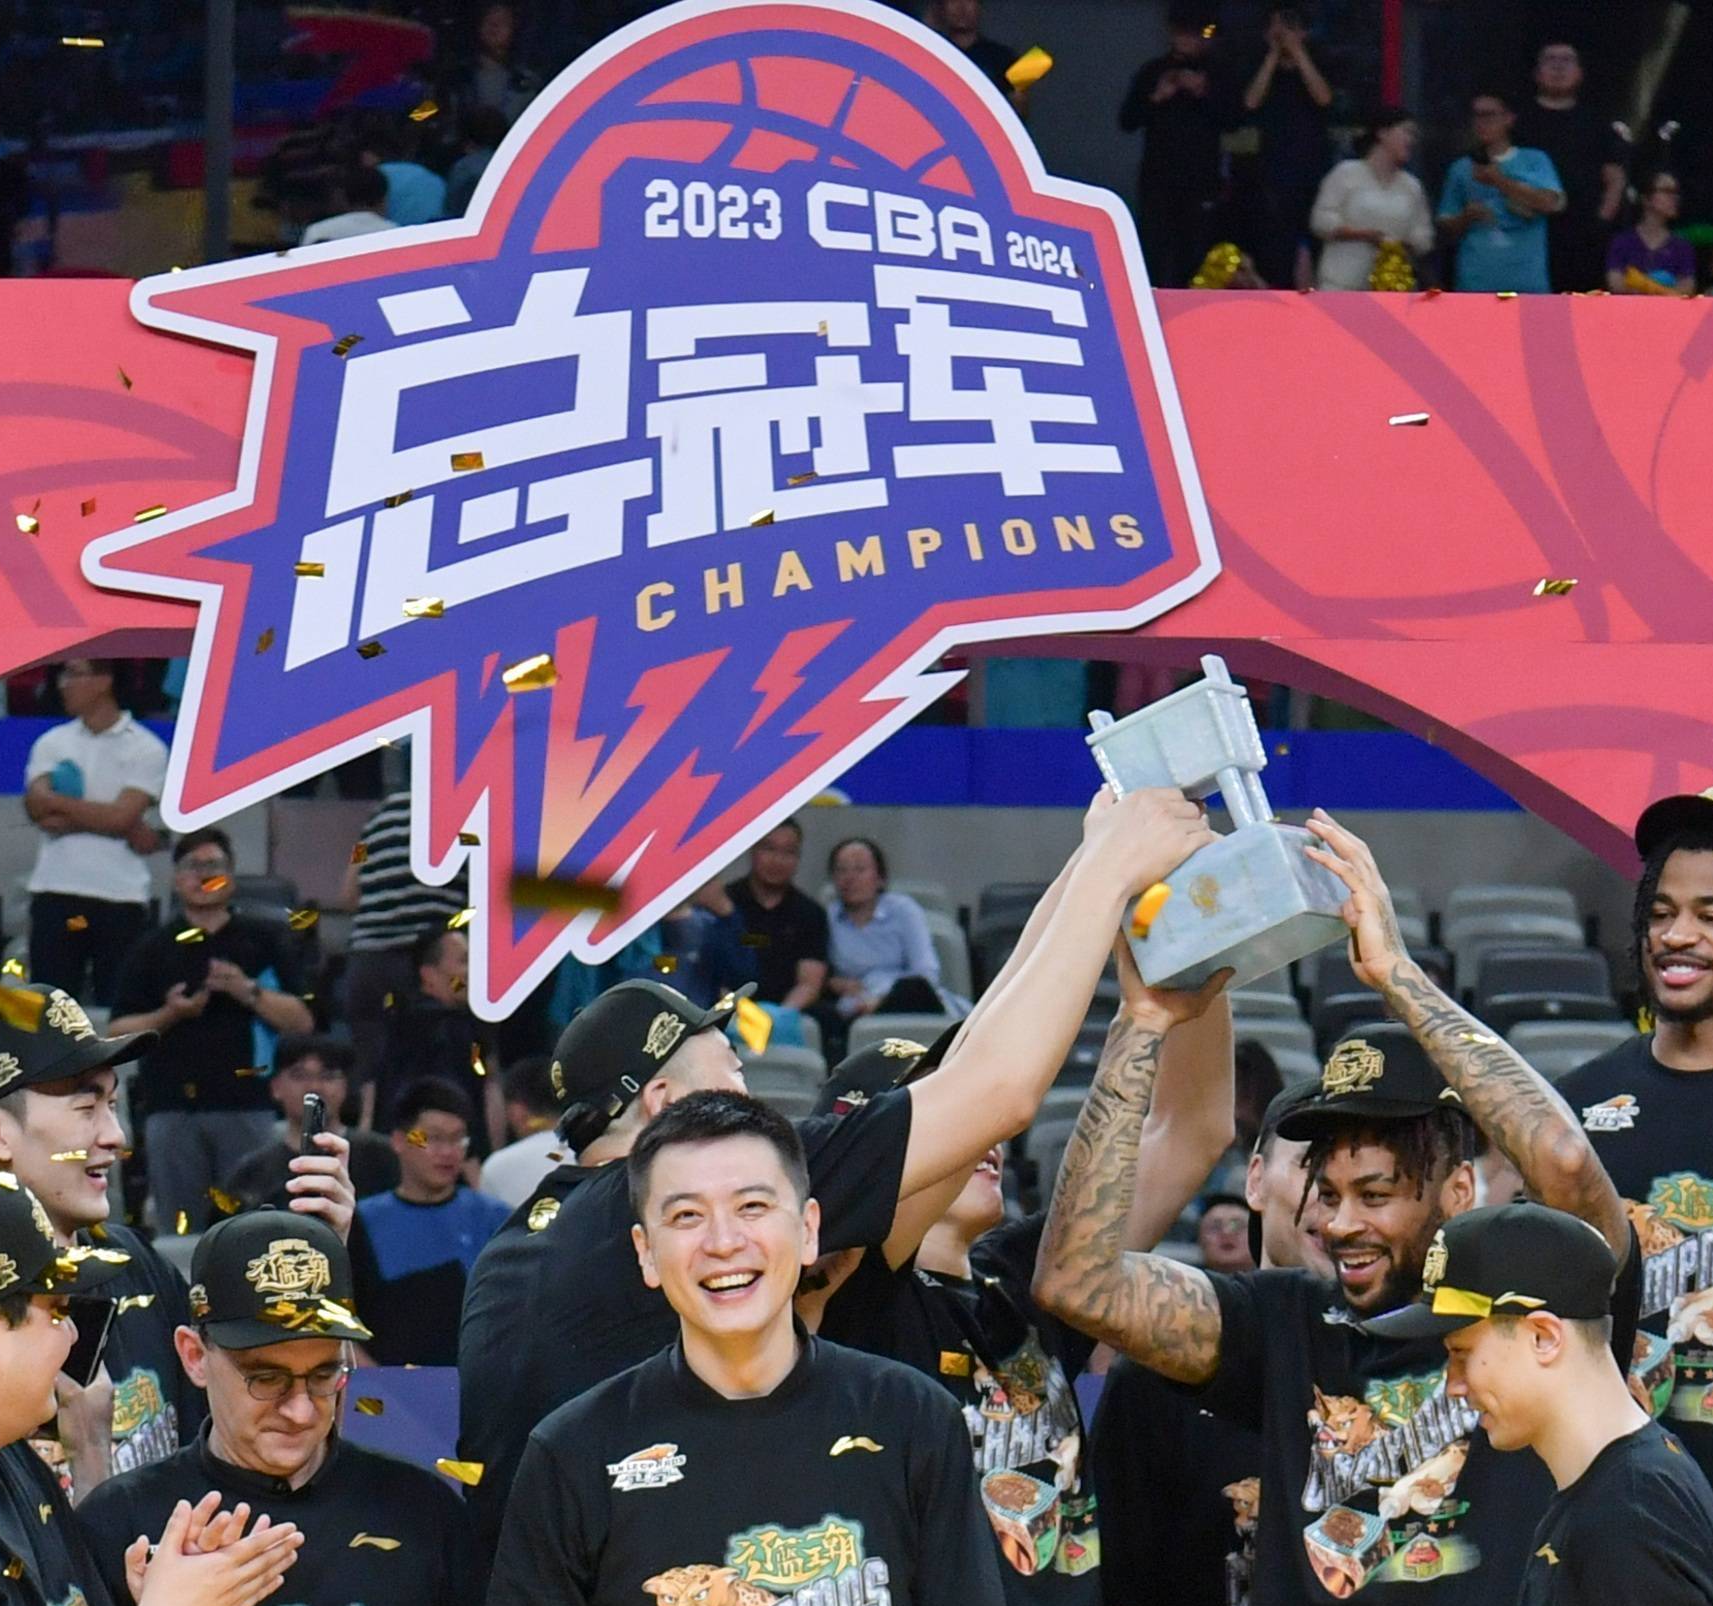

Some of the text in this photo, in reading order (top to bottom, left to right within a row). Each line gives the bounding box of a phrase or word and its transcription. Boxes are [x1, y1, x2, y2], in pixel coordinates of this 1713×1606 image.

[645, 179, 1077, 278] 2023 CBA 2024
[283, 266, 1122, 673] 总冠军
[637, 513, 1145, 632] CHAMPIONS
